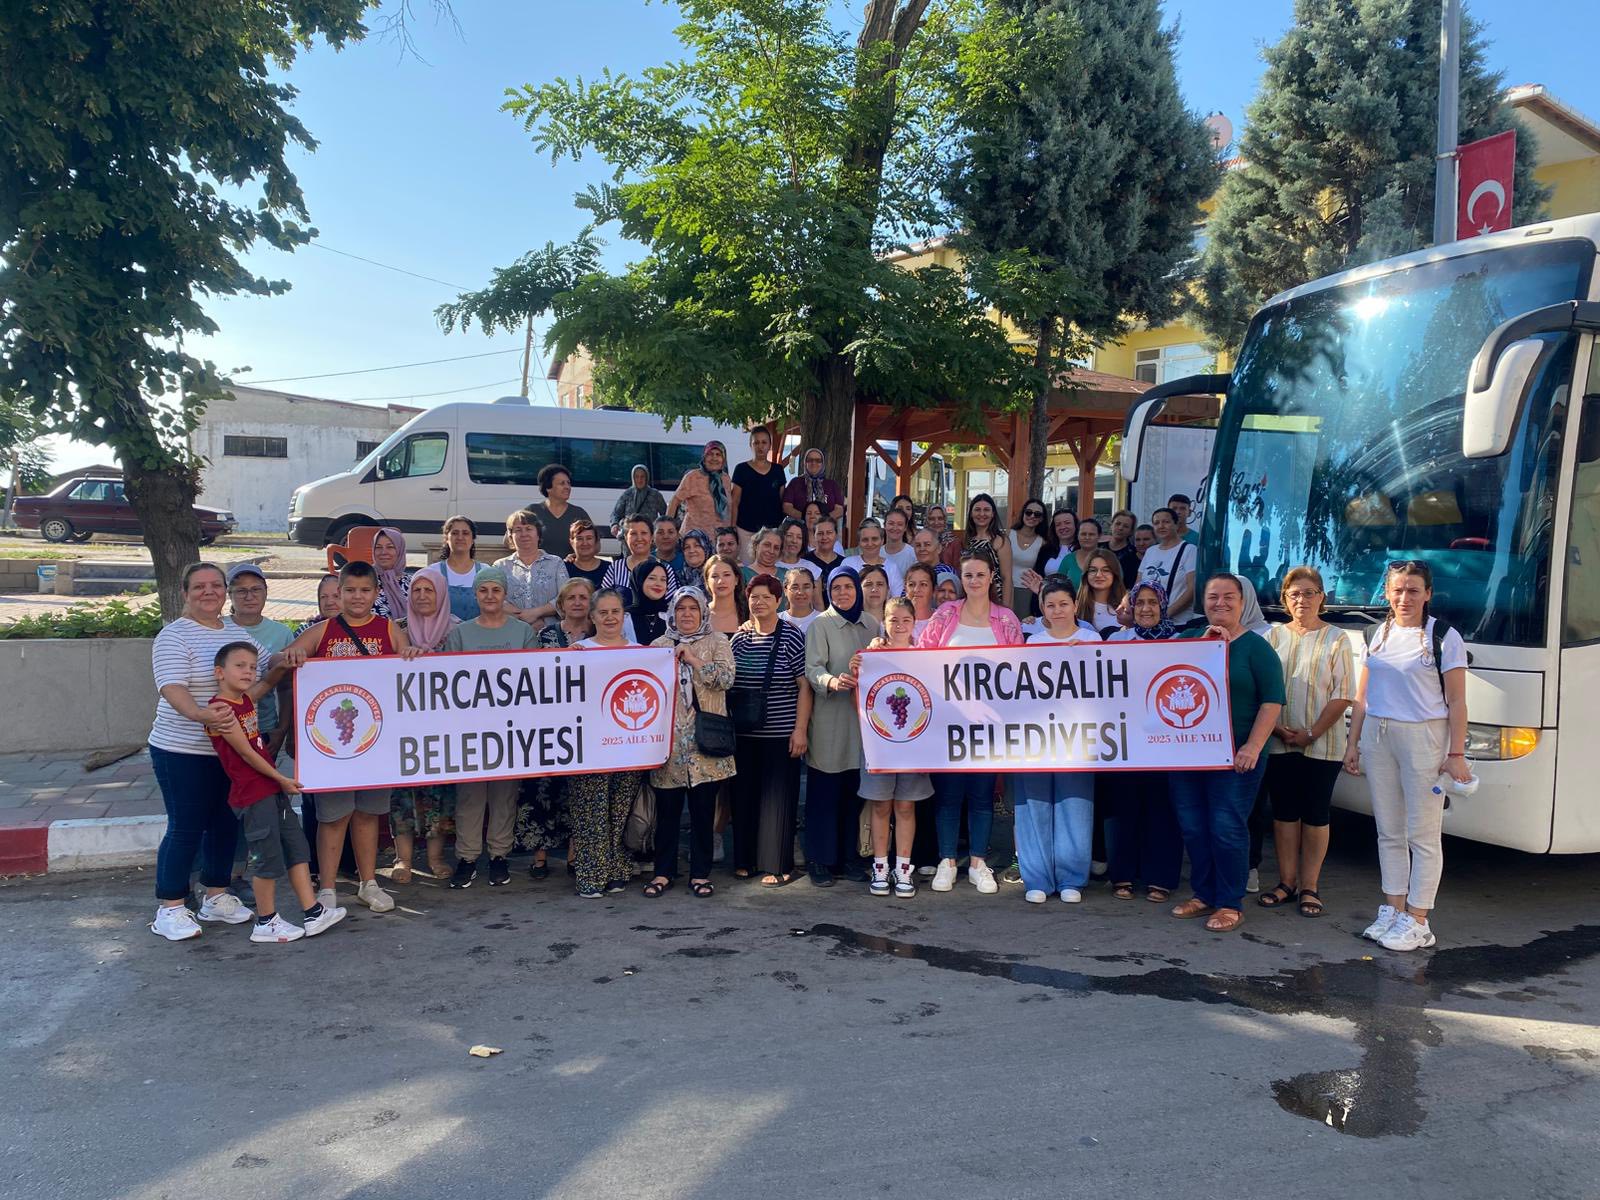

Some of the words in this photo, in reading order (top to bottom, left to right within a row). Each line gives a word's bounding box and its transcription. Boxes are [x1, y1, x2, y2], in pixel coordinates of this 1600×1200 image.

[328, 637, 383, 645] GALATARAY
[396, 655, 586, 712] KIRCASALİH
[943, 649, 1129, 701] KIRCASALİH
[399, 715, 584, 777] BELEDİYESİ
[601, 736, 624, 746] 2025
[626, 734, 648, 745] AİLE
[947, 711, 1129, 762] BELEDİYESİ
[1147, 735, 1171, 744] 2025
[1174, 732, 1198, 743] AİLE
